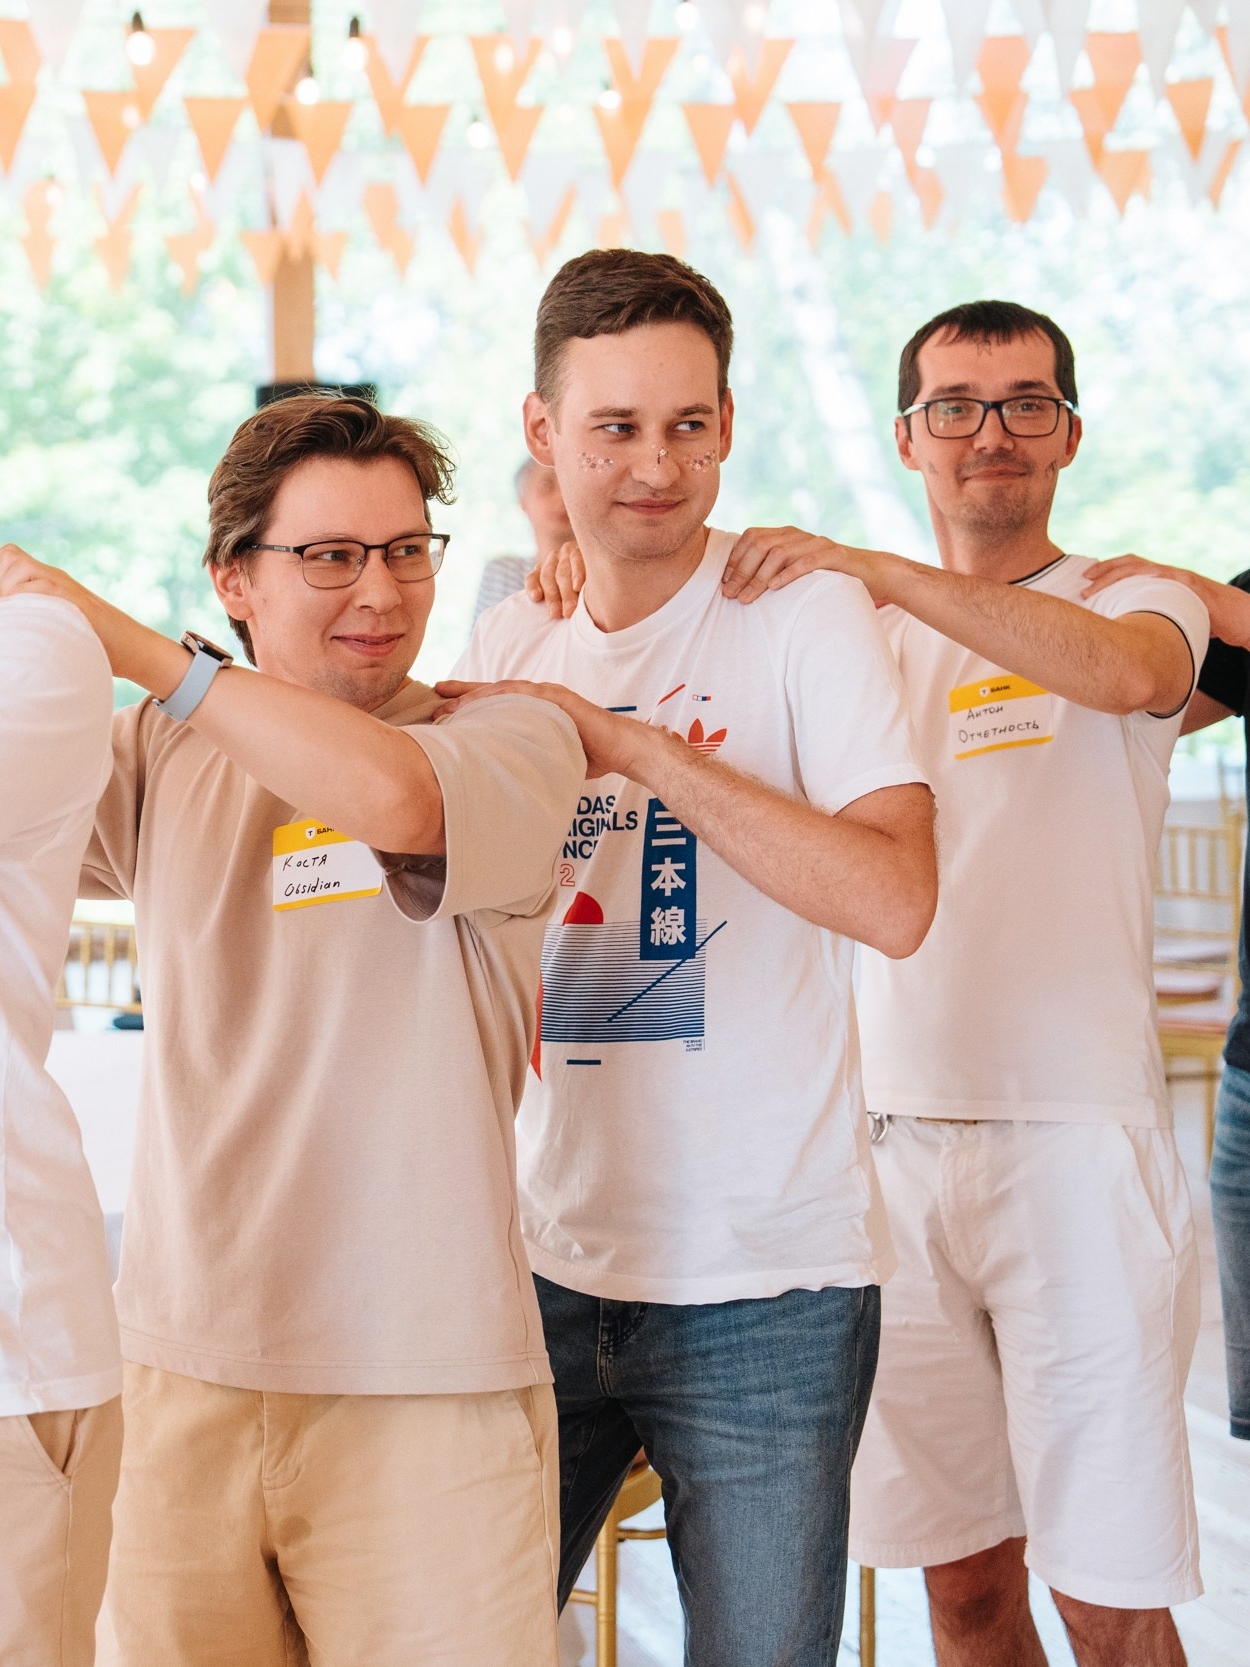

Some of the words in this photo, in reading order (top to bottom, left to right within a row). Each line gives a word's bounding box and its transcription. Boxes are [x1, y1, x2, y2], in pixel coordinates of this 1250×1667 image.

[316, 827, 335, 835] БАН
[284, 877, 341, 897] Obsidian
[650, 810, 687, 946] 三本線
